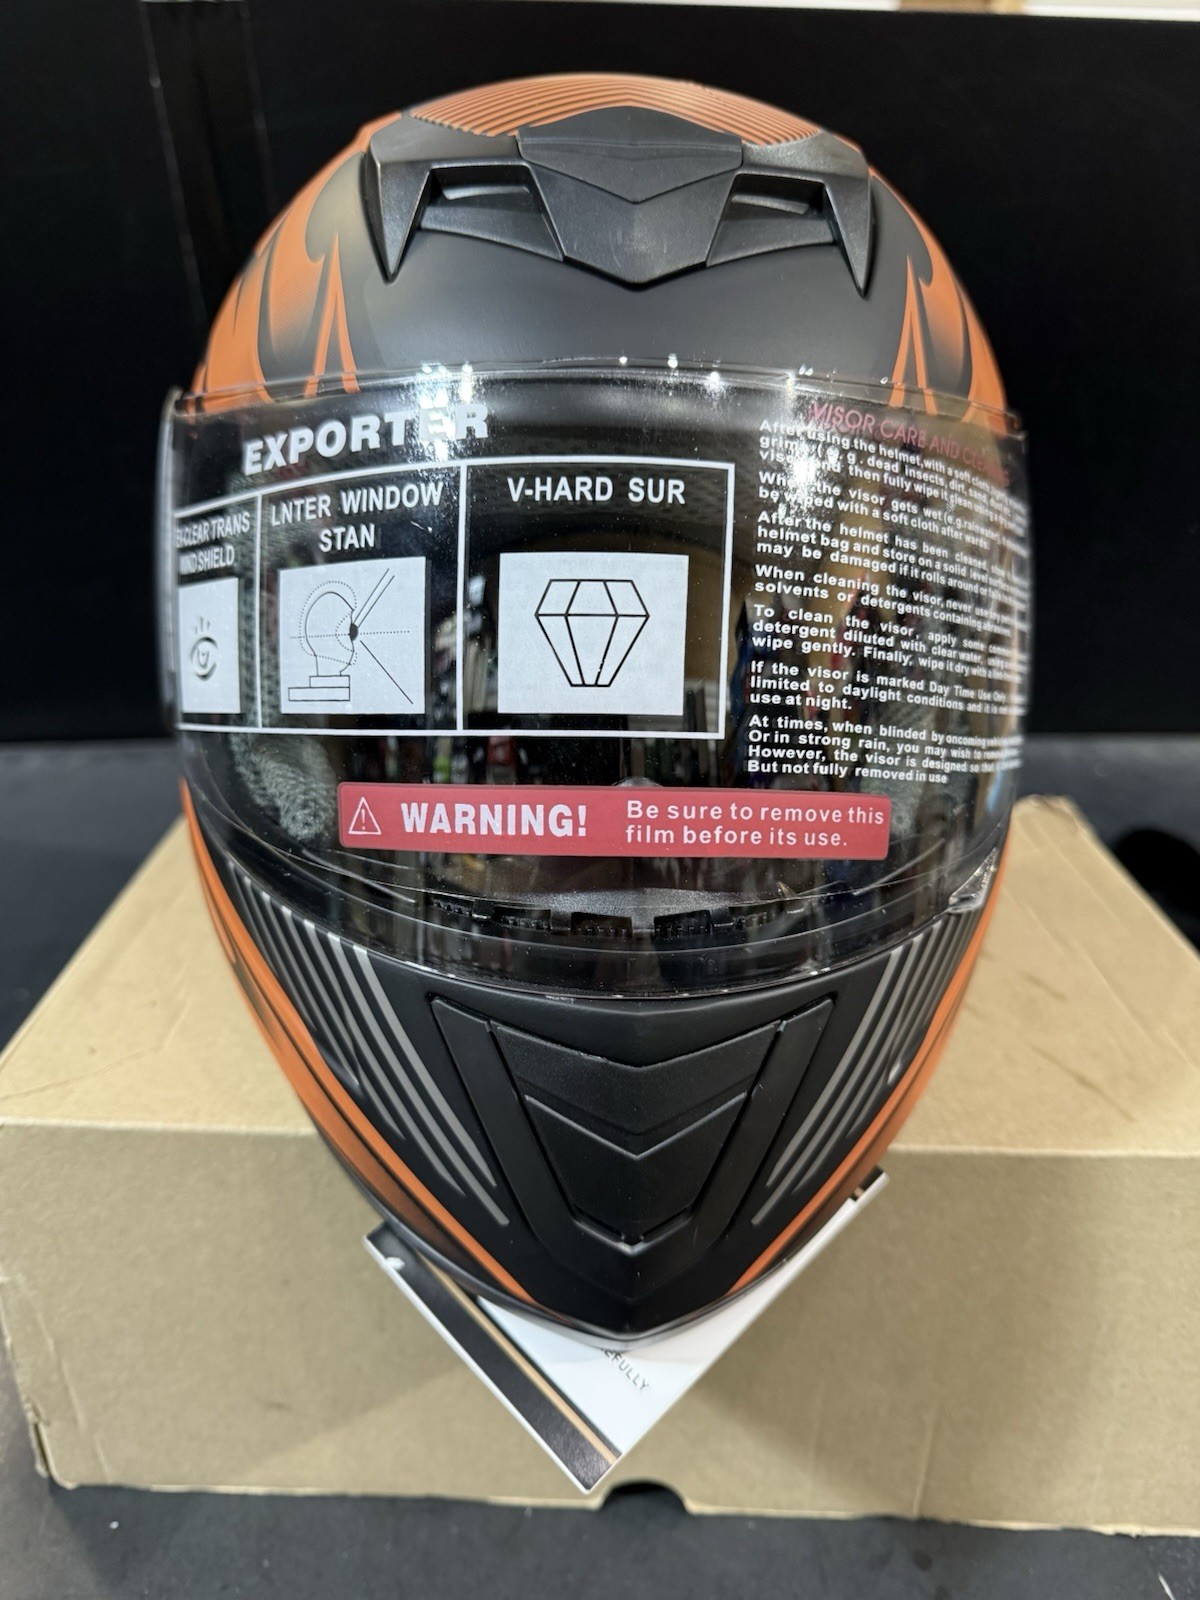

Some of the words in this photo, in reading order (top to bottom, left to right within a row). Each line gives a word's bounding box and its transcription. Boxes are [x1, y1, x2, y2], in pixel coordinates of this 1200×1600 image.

[243, 403, 489, 477] EXPORTER
[807, 428, 850, 450] using
[853, 438, 876, 454] the
[811, 399, 876, 434] VISOR
[880, 419, 926, 448] CARE
[928, 436, 960, 459] AND
[506, 475, 614, 503] V-HARD
[627, 476, 687, 505] SUR
[848, 464, 881, 483] then
[883, 472, 911, 492] fully
[913, 483, 940, 498] wipe
[867, 455, 900, 474] dead
[905, 465, 947, 488] insects,
[271, 494, 333, 527] LNTER
[340, 480, 445, 516] WINDOW
[758, 485, 780, 501] be
[837, 500, 869, 516] with
[872, 507, 880, 518] a
[883, 510, 909, 526] soft
[910, 516, 939, 534] cloth
[816, 480, 842, 496] the
[848, 487, 886, 506] visor
[891, 499, 919, 515] gets
[922, 506, 942, 521] wet
[211, 511, 251, 540] TRANS
[318, 522, 376, 553] STAN
[757, 510, 802, 528] After
[805, 516, 832, 532] the
[839, 522, 889, 545] helmet
[894, 534, 918, 551] has
[922, 541, 949, 559] been
[198, 543, 236, 572] SHIELD
[757, 525, 817, 544] helmet
[820, 533, 850, 553] bag
[852, 542, 880, 556] and
[882, 547, 916, 564] store
[918, 557, 933, 568] on
[934, 560, 942, 571] a
[942, 561, 967, 578] solid
[757, 541, 793, 559] may
[801, 544, 823, 560] be
[829, 551, 897, 574] damaged
[899, 563, 909, 576] if
[910, 565, 920, 579] it
[921, 570, 946, 585] rolls
[946, 576, 979, 594] around
[754, 580, 830, 600] solvents
[836, 592, 854, 603] or
[860, 593, 931, 617] detergents
[932, 609, 982, 632] containing
[755, 564, 806, 581] When
[813, 572, 880, 596] cleaning
[886, 584, 908, 599] the
[912, 590, 944, 608] visor,
[945, 598, 972, 613] never
[752, 619, 836, 639] detergent
[843, 629, 895, 648] diluted
[900, 639, 927, 653] with
[931, 644, 957, 660] clear
[754, 603, 775, 618] To
[787, 607, 834, 624] clean
[845, 614, 870, 630] the
[927, 631, 957, 647] apply
[961, 639, 986, 652] some
[752, 634, 794, 651] wipe
[801, 640, 856, 659] gently.
[918, 657, 946, 671] wipe
[954, 662, 970, 677] dry
[749, 675, 811, 692] limited
[817, 681, 836, 694] to
[842, 683, 902, 703] daylight
[906, 693, 965, 712] conditions
[966, 702, 983, 714] and
[750, 660, 765, 674] If
[771, 662, 800, 677] the
[806, 666, 849, 681] visor
[856, 670, 870, 684] is
[876, 675, 925, 691] marked
[929, 680, 950, 697] Day
[953, 684, 976, 699] Time
[977, 688, 992, 701] Use
[749, 692, 782, 705] use
[785, 693, 802, 706] at
[805, 694, 853, 712] night.
[748, 713, 770, 728] At
[776, 716, 829, 732] times,
[832, 720, 873, 735] when
[879, 724, 927, 741] blinded
[931, 729, 945, 746] by
[748, 729, 771, 743] Or
[773, 730, 790, 744] in
[797, 732, 852, 750] strong
[858, 737, 890, 753] rain,
[896, 742, 920, 756] you
[924, 745, 948, 760] may
[950, 748, 972, 760] wish
[747, 759, 779, 774] But
[782, 762, 810, 775] not
[812, 761, 849, 779] fully
[854, 766, 914, 782] removed
[915, 769, 927, 782] in
[928, 773, 949, 785] use
[748, 744, 827, 763] However,
[833, 749, 859, 763] the
[865, 752, 901, 767] visor
[906, 755, 917, 768] is
[921, 757, 968, 773] designed
[400, 802, 588, 838] WARNING!
[627, 799, 660, 820] Be
[667, 802, 723, 821] sure
[730, 802, 754, 821] to
[760, 806, 843, 824] remove
[848, 806, 885, 825] this
[626, 825, 676, 844] film
[683, 825, 763, 846] before
[769, 828, 798, 847] its
[804, 830, 848, 847] use.
